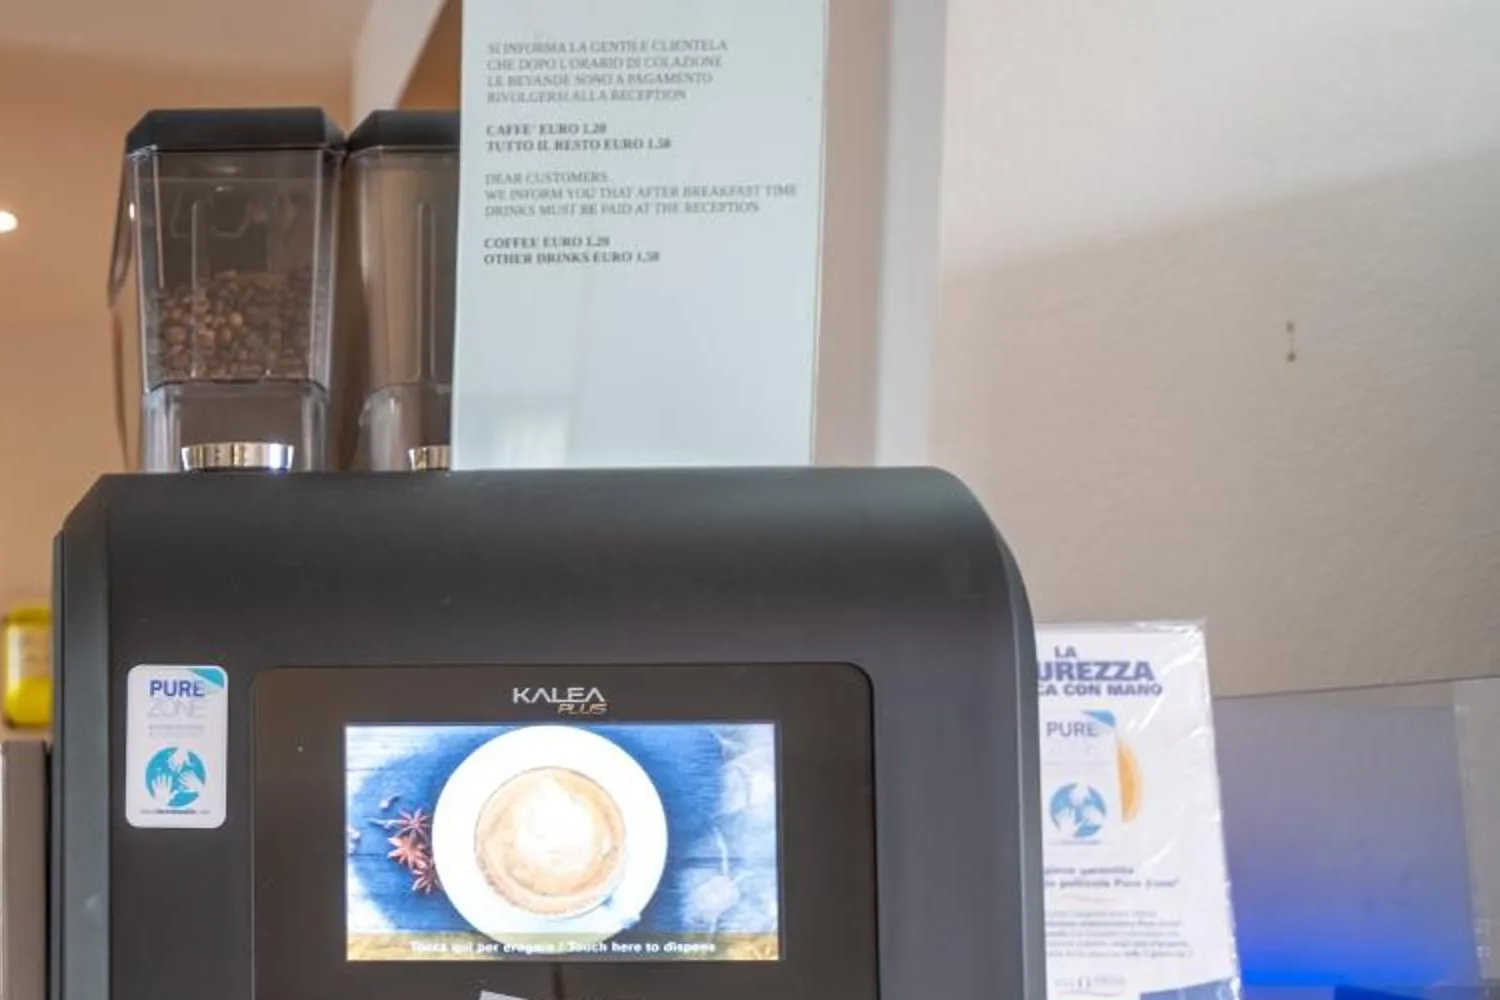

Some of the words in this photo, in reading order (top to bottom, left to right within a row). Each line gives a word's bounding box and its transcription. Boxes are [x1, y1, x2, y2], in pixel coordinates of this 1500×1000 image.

[503, 41, 567, 54] INFORMA
[588, 39, 648, 52] GENTILE
[650, 38, 728, 51] CLIENTELA
[486, 59, 514, 70] CHE
[518, 58, 556, 70] DOPO
[644, 55, 723, 68] COLAZIONE
[508, 74, 568, 87] BEVANDE
[574, 73, 612, 86] SONO
[628, 71, 712, 85] PAGAMENTO
[486, 90, 572, 104] RIVOLGERSI
[573, 89, 607, 103] ALLA
[610, 88, 686, 102] RECEPTION
[538, 121, 579, 135] EURO
[486, 139, 533, 152] TUTTO
[554, 138, 600, 151] RESTO
[604, 137, 644, 151] EURO
[484, 171, 522, 185] DEAR
[510, 187, 563, 201] INFORM
[566, 186, 596, 200] YOU
[600, 186, 634, 199] THAT
[636, 185, 678, 198] AFTER
[682, 183, 760, 198] BREAKFAST
[764, 183, 797, 196] TIME
[484, 204, 536, 218] DRINKS
[539, 203, 574, 217] MUST
[600, 202, 632, 216] PAID
[654, 201, 678, 215] THE
[684, 200, 759, 215] RECEPTION
[484, 236, 538, 249] COFFEE
[542, 235, 582, 248] EURO
[484, 252, 532, 266] OTHER
[536, 251, 590, 265] DRINKS
[592, 250, 633, 264] EURO
[1054, 645, 1077, 658] LA
[150, 679, 205, 697] PURE
[513, 687, 605, 703] KALEA
[1063, 684, 1101, 697] CON
[1106, 683, 1163, 697] MANO
[557, 703, 609, 715] PLUS
[1046, 721, 1099, 737] PURE
[477, 943, 499, 956] per
[568, 941, 606, 953] Touch
[612, 941, 640, 953] here
[645, 942, 659, 953] to
